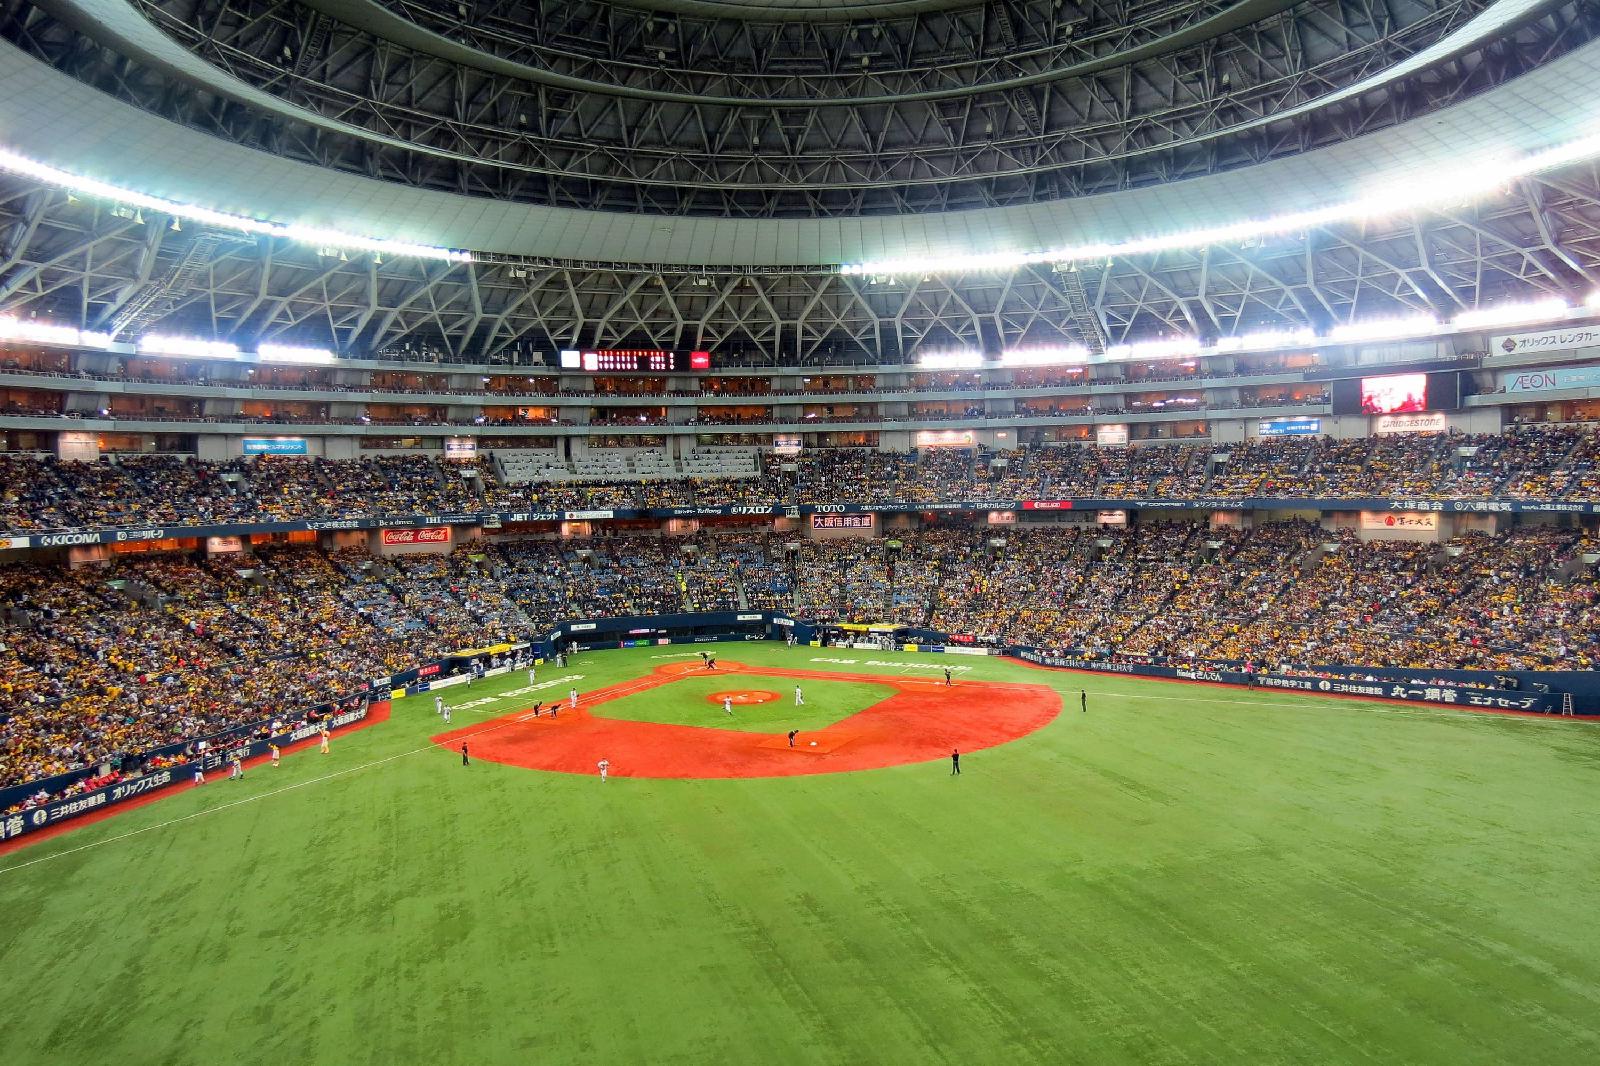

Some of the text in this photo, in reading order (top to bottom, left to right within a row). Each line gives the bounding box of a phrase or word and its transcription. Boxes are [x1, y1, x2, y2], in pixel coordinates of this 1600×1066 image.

[1519, 332, 1599, 348] オリックス レンタカー
[1382, 419, 1441, 428] BRIDGESTONE
[815, 504, 846, 513] TOTO
[1389, 500, 1444, 510] 大塚商会
[1463, 501, 1513, 511] 六興電気
[426, 516, 441, 524] IHI
[511, 513, 529, 521] JET
[814, 517, 871, 527] 大阪信用金庫
[312, 521, 360, 529] さつき株式会社
[379, 519, 388, 527] Be
[394, 518, 415, 526] driver.
[52, 533, 101, 545] KICONA
[1333, 683, 1383, 696] 三井住友建設
[1391, 684, 1457, 702] 丸一鋼管
[1469, 696, 1538, 709] エナセーブ
[112, 771, 171, 800] オリックス生命
[50, 793, 107, 820] 三井住友建設
